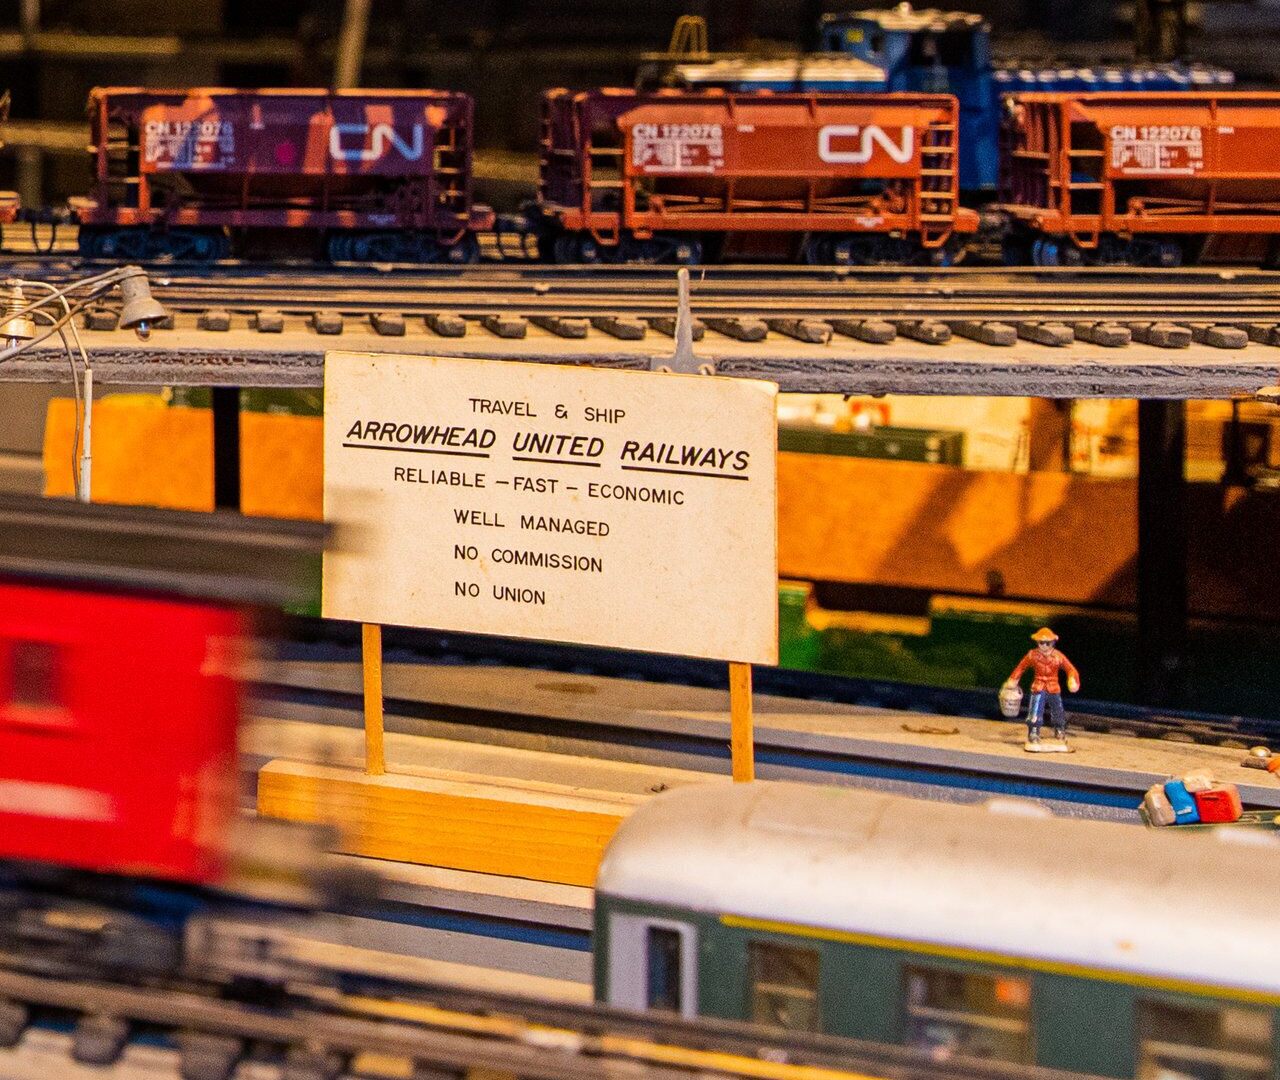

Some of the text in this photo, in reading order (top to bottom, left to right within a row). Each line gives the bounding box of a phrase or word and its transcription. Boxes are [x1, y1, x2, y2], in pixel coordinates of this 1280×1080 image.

[329, 123, 423, 160] CN
[818, 125, 914, 163] CN
[469, 398, 626, 424] TRAVEL & SHIP
[346, 420, 750, 471] ARROWHEAD UNITED RAILWAYS
[394, 467, 486, 488] RELIABLE
[588, 482, 684, 505] ECONOMIC
[454, 508, 610, 537] WELL MANAGED
[454, 544, 603, 573] NO COMMISSION
[455, 581, 546, 605] NO UNION
